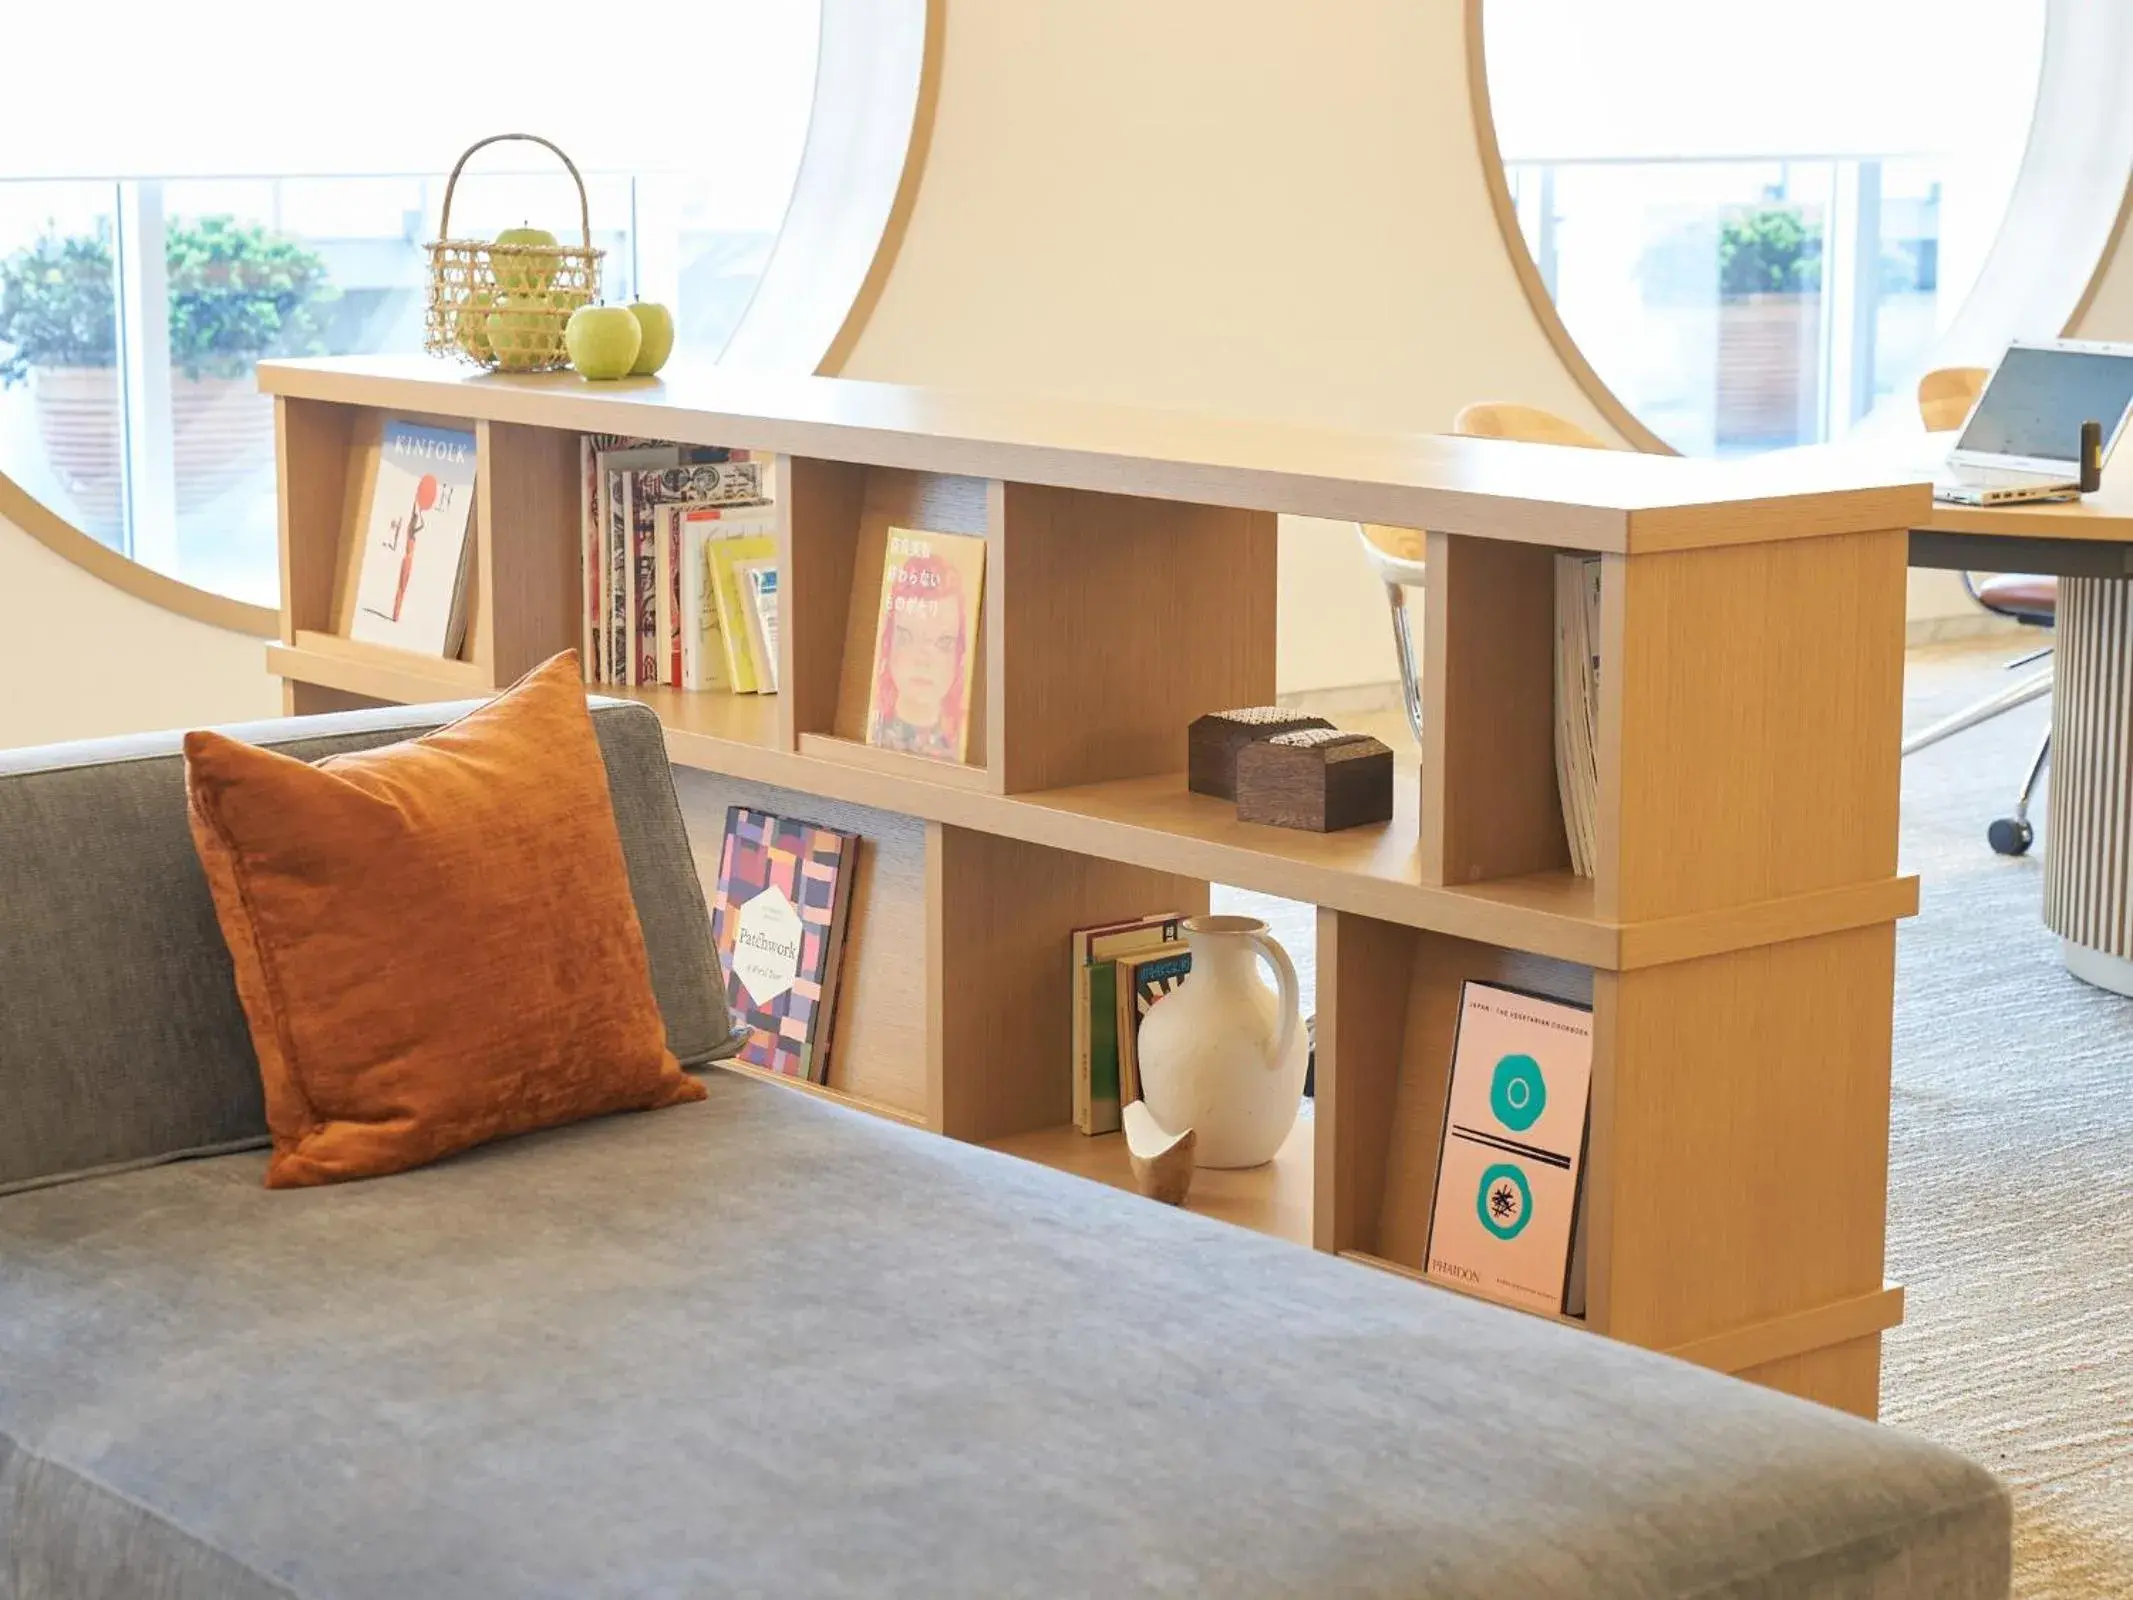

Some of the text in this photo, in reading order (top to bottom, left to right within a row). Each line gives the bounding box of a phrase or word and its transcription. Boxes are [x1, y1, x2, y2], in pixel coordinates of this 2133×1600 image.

[394, 435, 467, 465] KINFOLK
[739, 927, 796, 960] Patchwork
[1509, 1011, 1550, 1028] VEGETARIAN
[1551, 1022, 1589, 1037] COOKBOOK
[1432, 1259, 1480, 1284] PHAIDON
